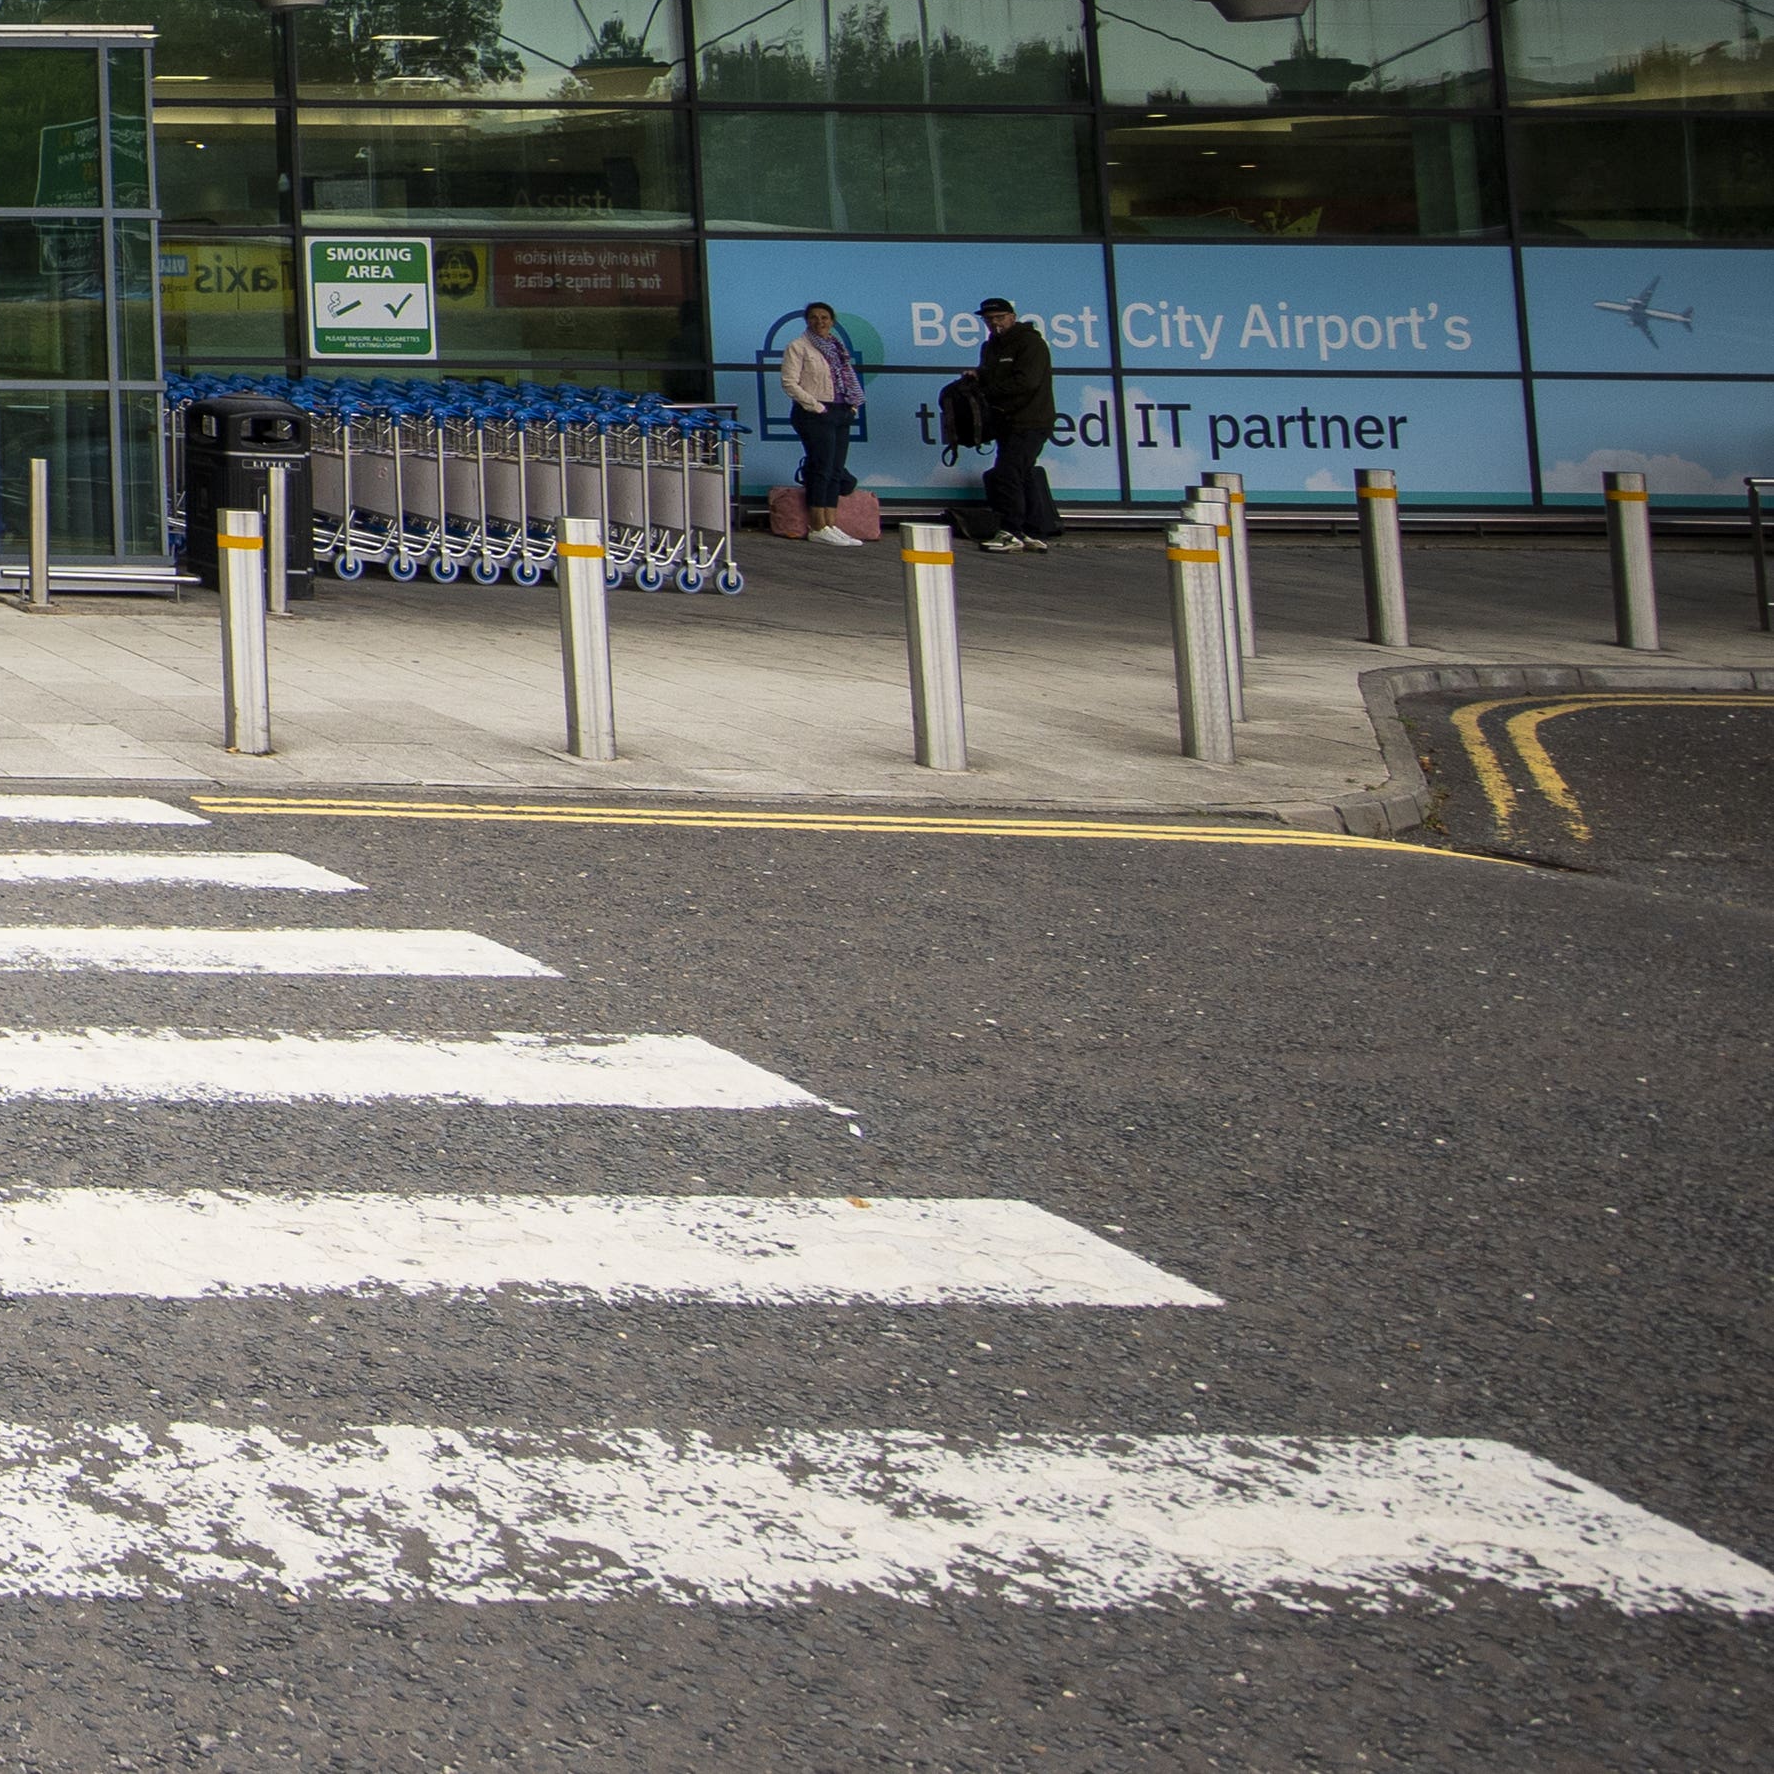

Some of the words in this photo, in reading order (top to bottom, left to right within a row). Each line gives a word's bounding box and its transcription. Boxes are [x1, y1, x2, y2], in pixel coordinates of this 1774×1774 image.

[509, 187, 615, 216] Assist
[326, 247, 412, 261] SMOKING
[346, 265, 394, 279] AREA
[911, 300, 1100, 348] Beast
[1121, 301, 1223, 360] City
[1239, 302, 1472, 361] Airport's
[1134, 403, 1191, 448] IT
[1208, 406, 1408, 461] partner
[253, 460, 291, 468] LITTER
